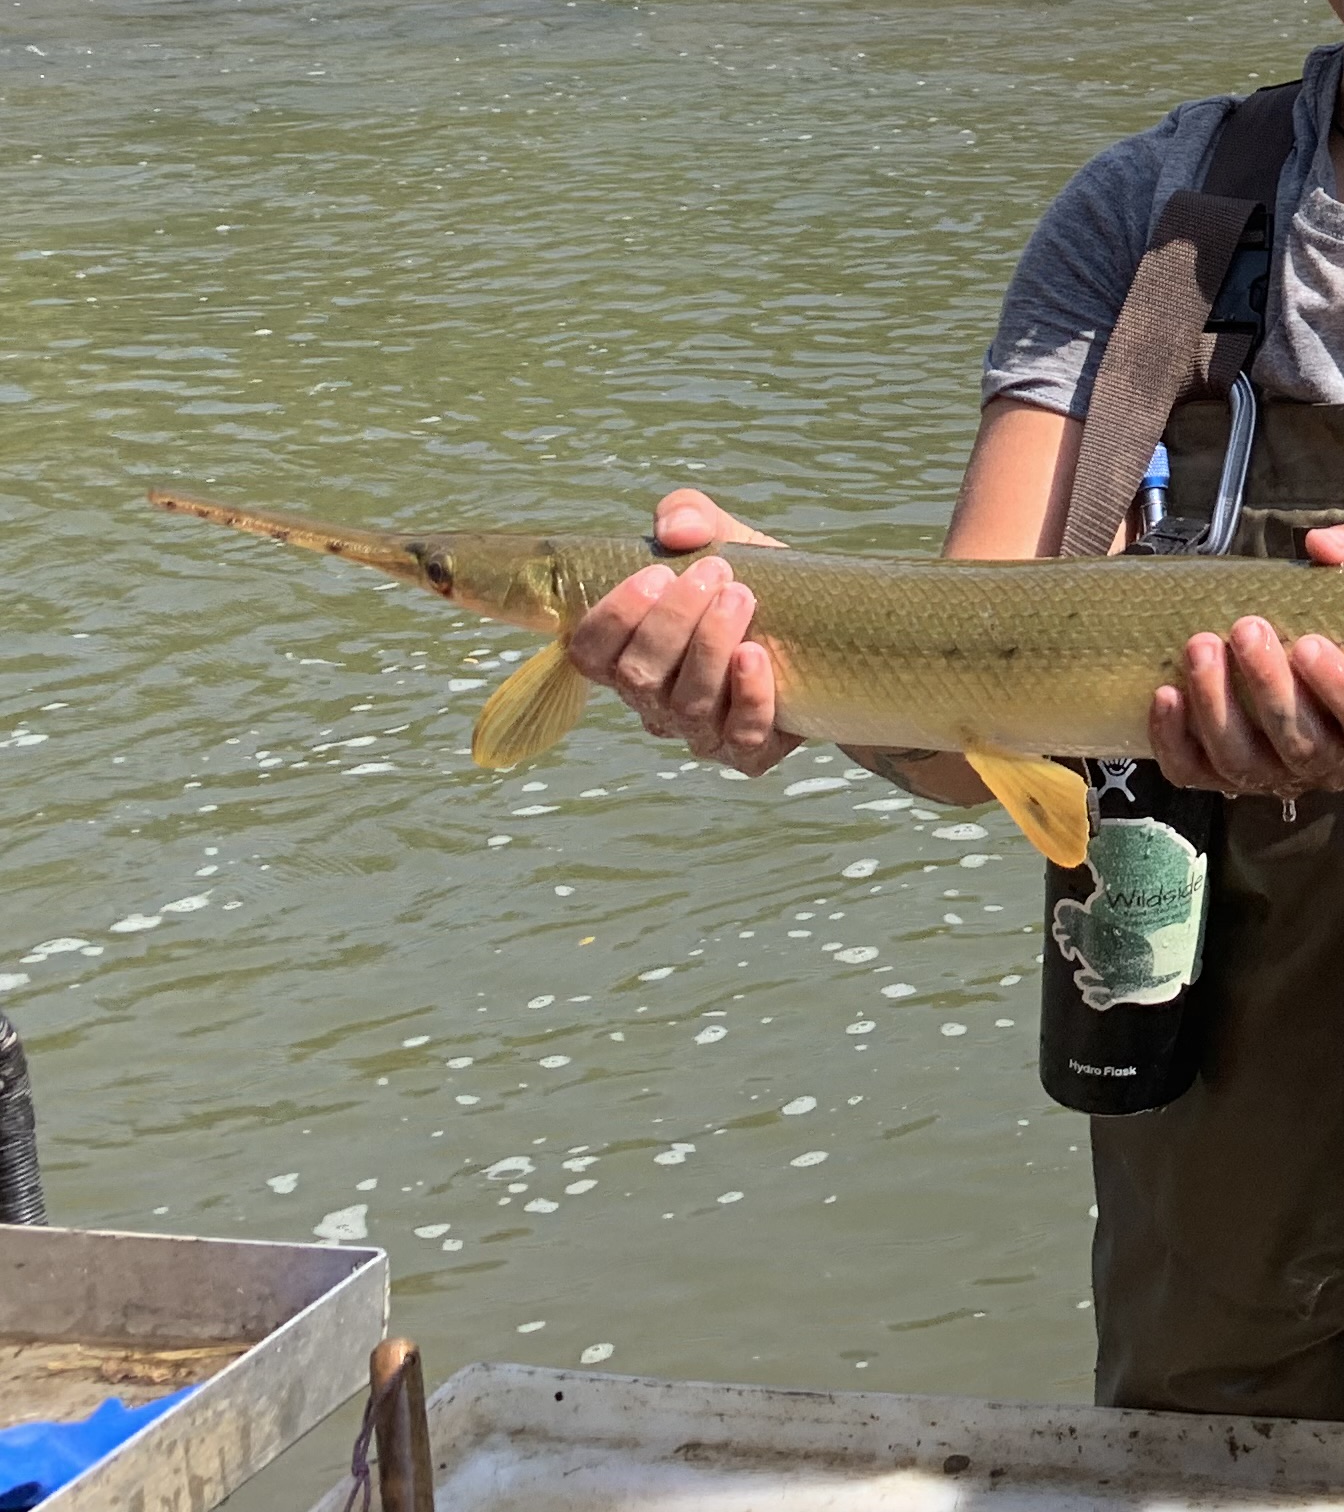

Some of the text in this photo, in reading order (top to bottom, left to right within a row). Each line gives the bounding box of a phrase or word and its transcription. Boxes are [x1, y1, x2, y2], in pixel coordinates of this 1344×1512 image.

[1104, 872, 1203, 909] Wildside
[1068, 1058, 1137, 1077] Hydro Flask
